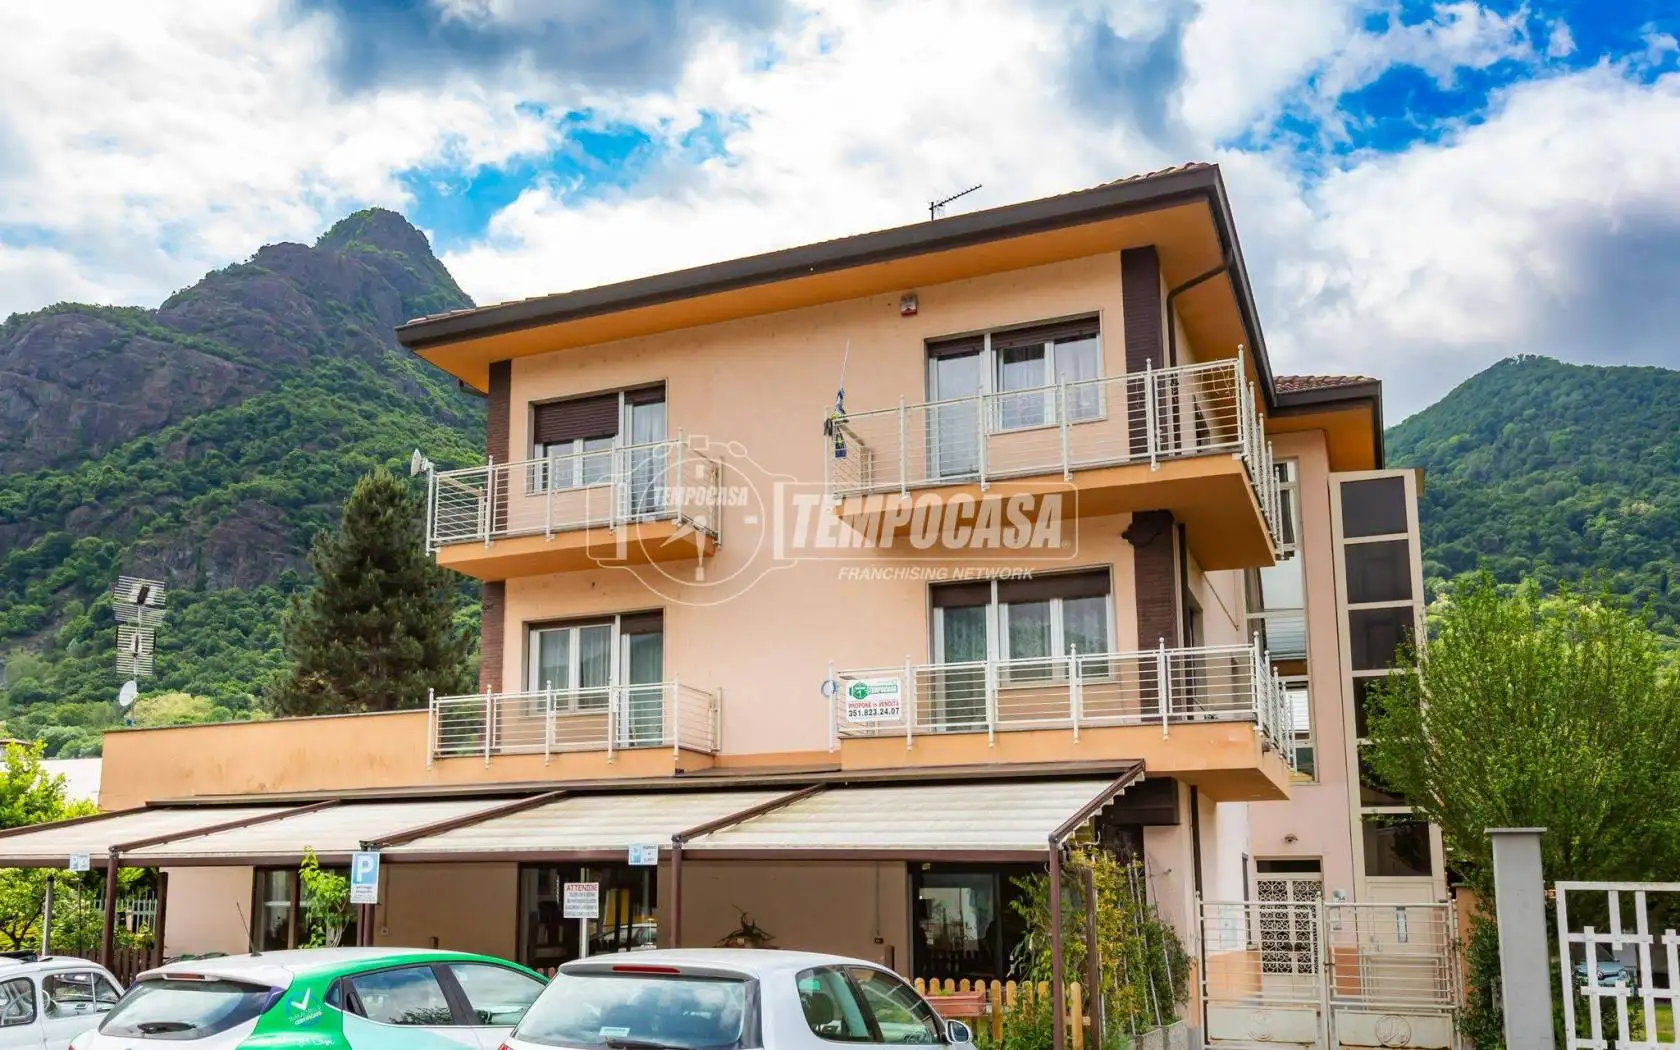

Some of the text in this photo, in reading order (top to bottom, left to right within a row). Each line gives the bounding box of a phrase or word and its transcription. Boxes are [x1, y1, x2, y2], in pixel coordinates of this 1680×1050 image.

[879, 700, 899, 708] VENDITA
[848, 708, 900, 717] 351.823.24.07
[356, 855, 374, 882] P
